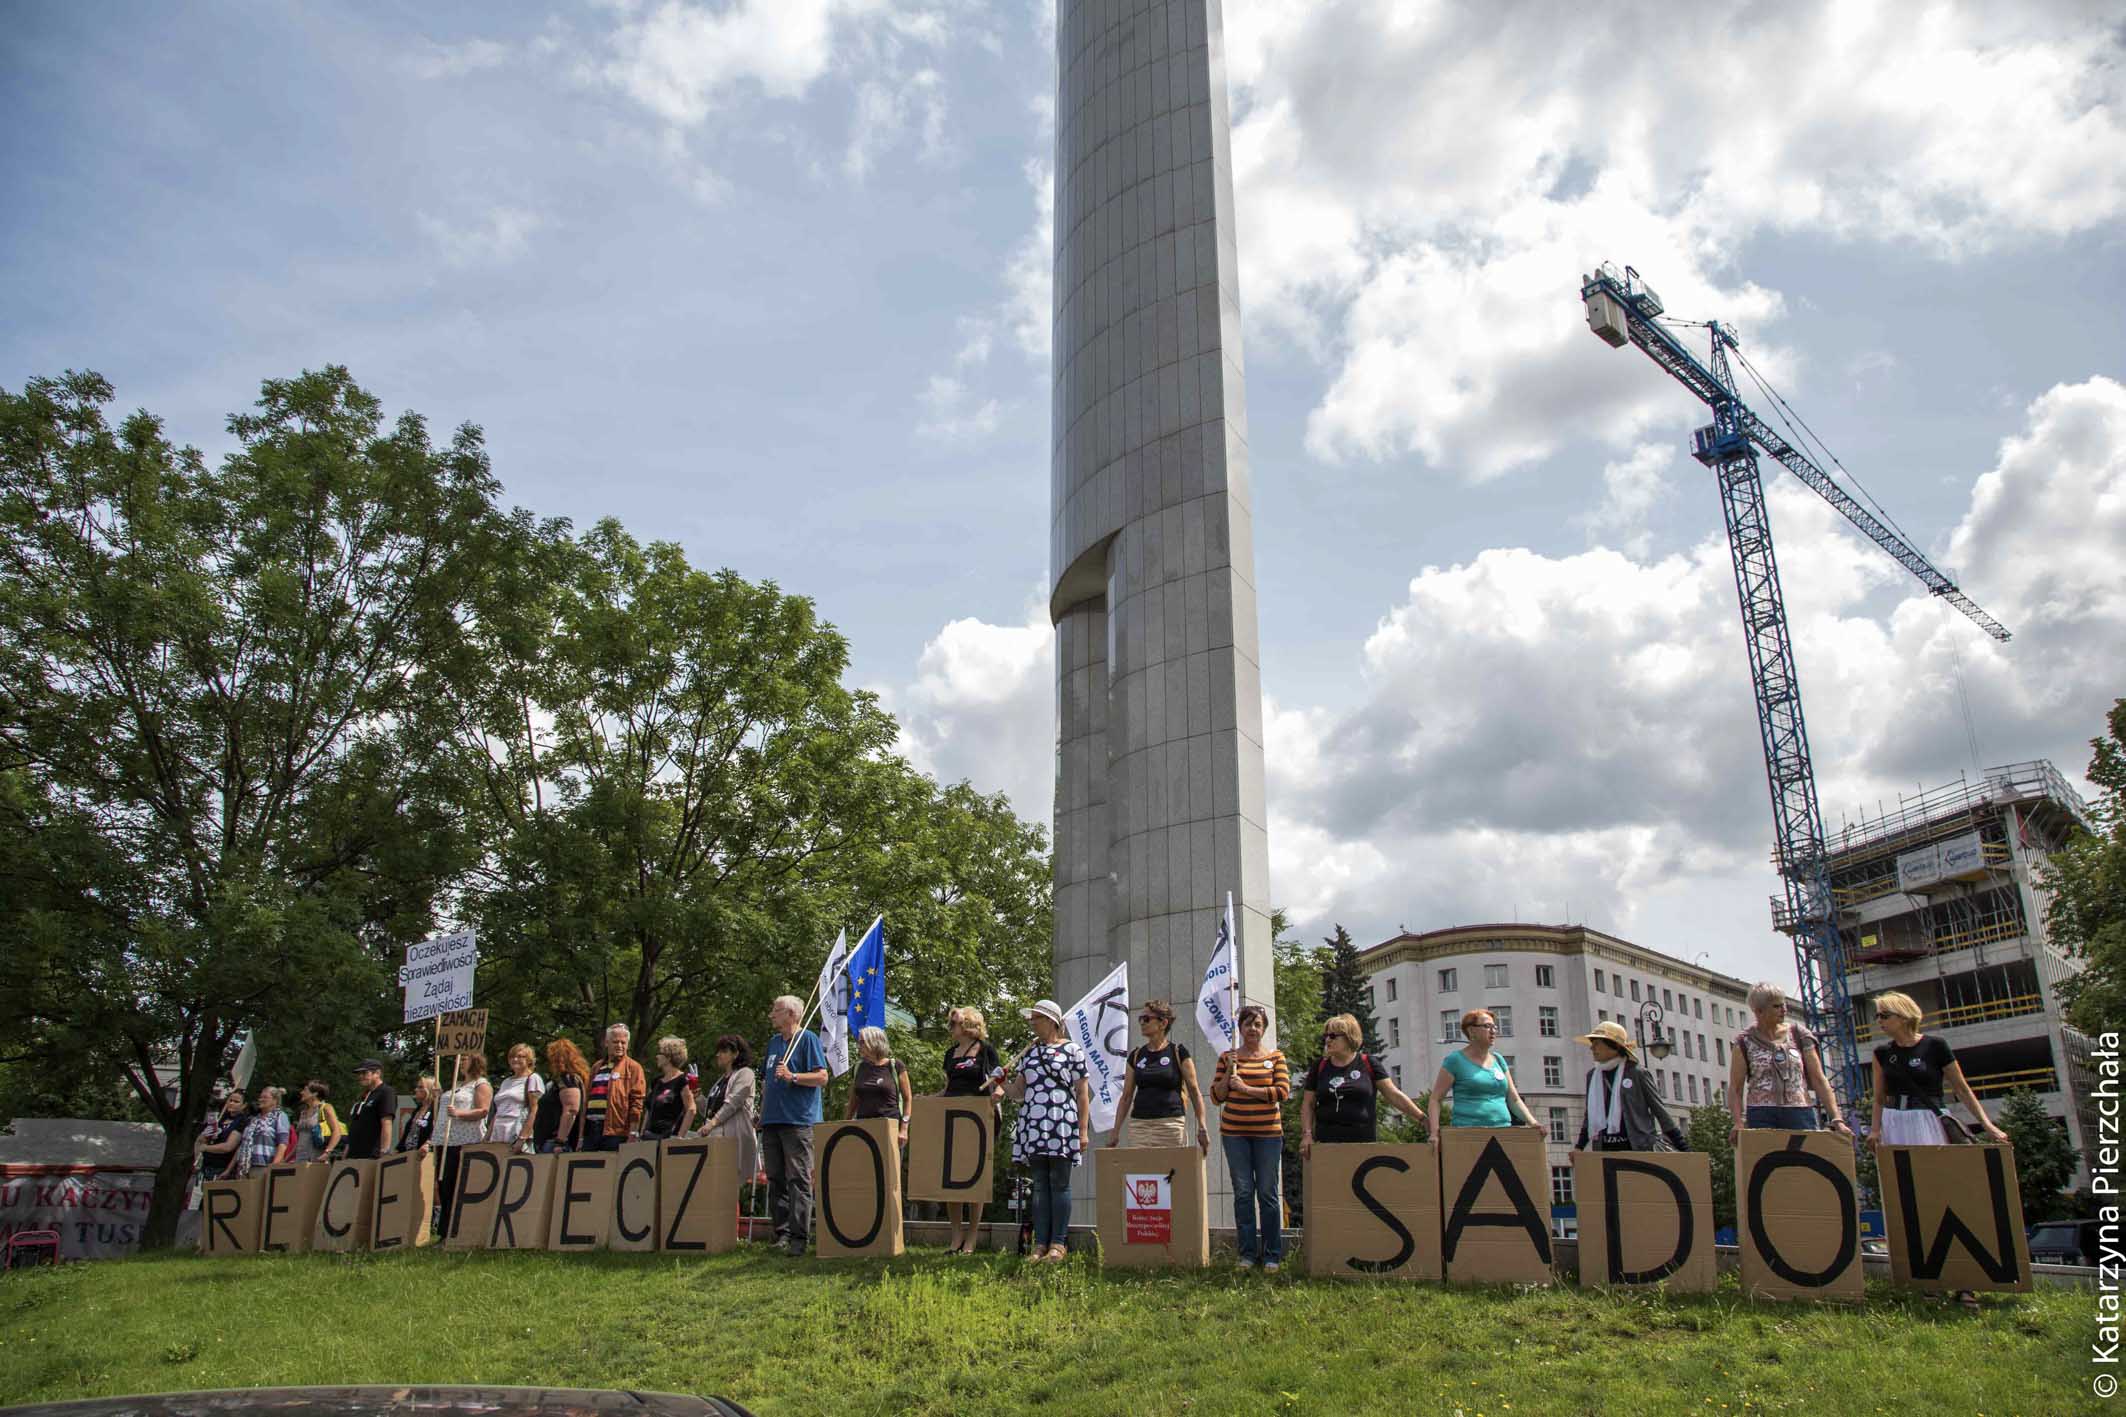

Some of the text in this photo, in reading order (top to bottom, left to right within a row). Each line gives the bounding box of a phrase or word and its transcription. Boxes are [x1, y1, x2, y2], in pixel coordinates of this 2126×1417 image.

[409, 936, 468, 962] Oczekujesz
[423, 976, 454, 999] Żądaj
[1075, 1008, 1112, 1105] REGION MAZSZE
[450, 1144, 708, 1250] PRECZ
[821, 1109, 987, 1249] OD
[75, 1221, 145, 1246] TUS
